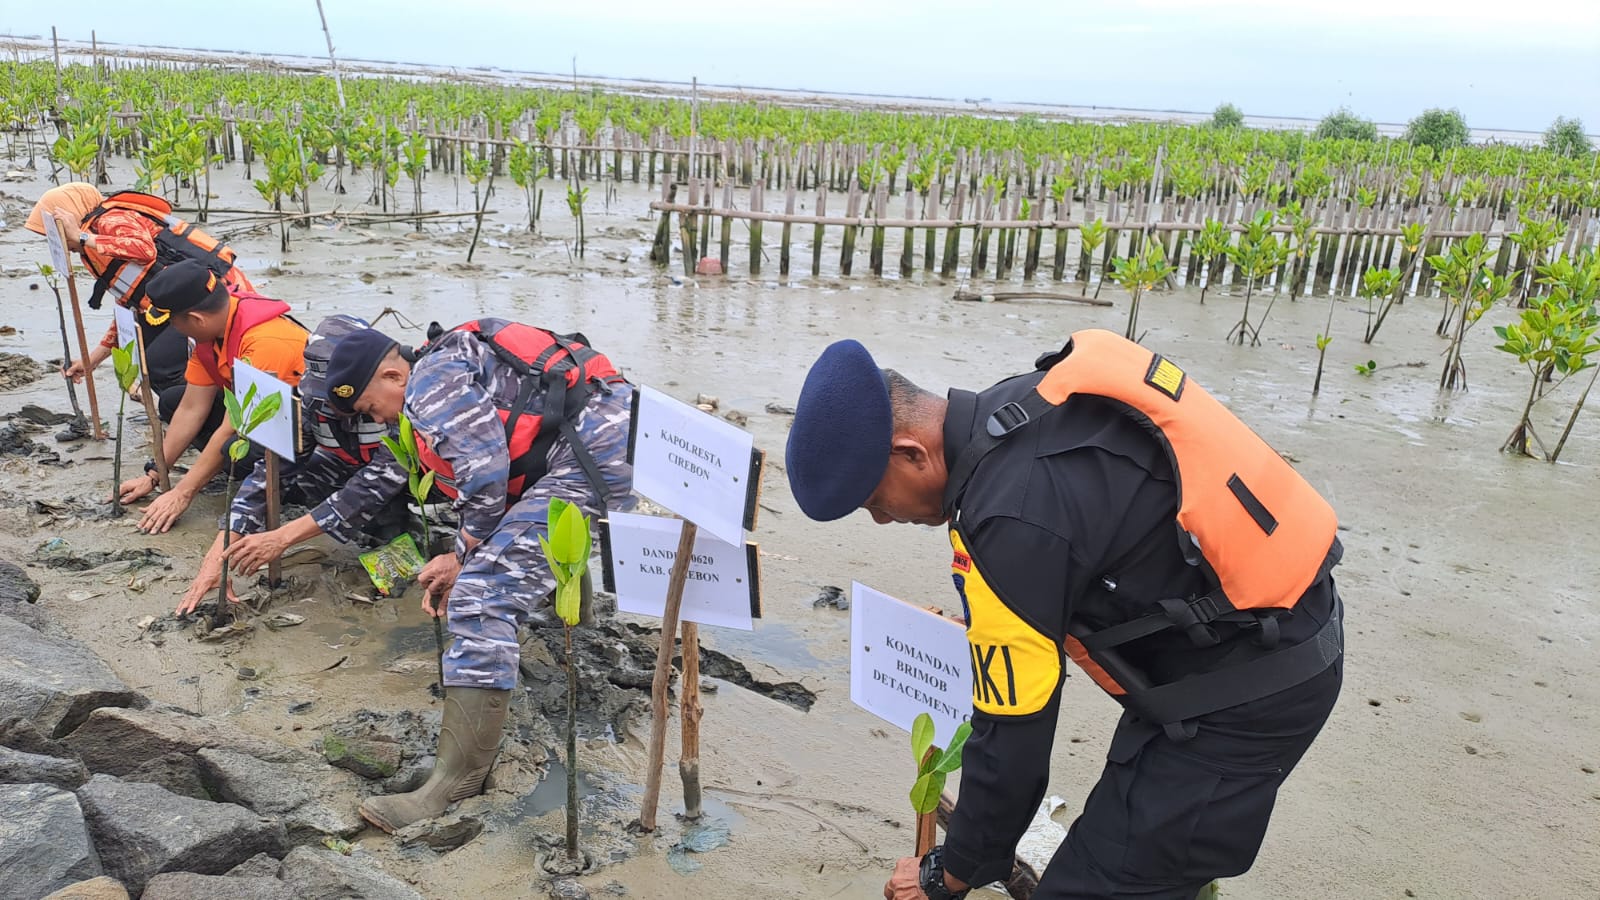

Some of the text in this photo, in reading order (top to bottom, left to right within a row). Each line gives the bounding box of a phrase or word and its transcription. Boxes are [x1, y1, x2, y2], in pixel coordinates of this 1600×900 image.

[660, 429, 721, 467] KAPOLRESTA
[668, 452, 709, 480] CIREBON
[640, 564, 666, 576] KAB.
[886, 635, 960, 679] KOMANDAN
[896, 659, 947, 692] BRIMOB
[873, 669, 959, 720] DETACEMENT
